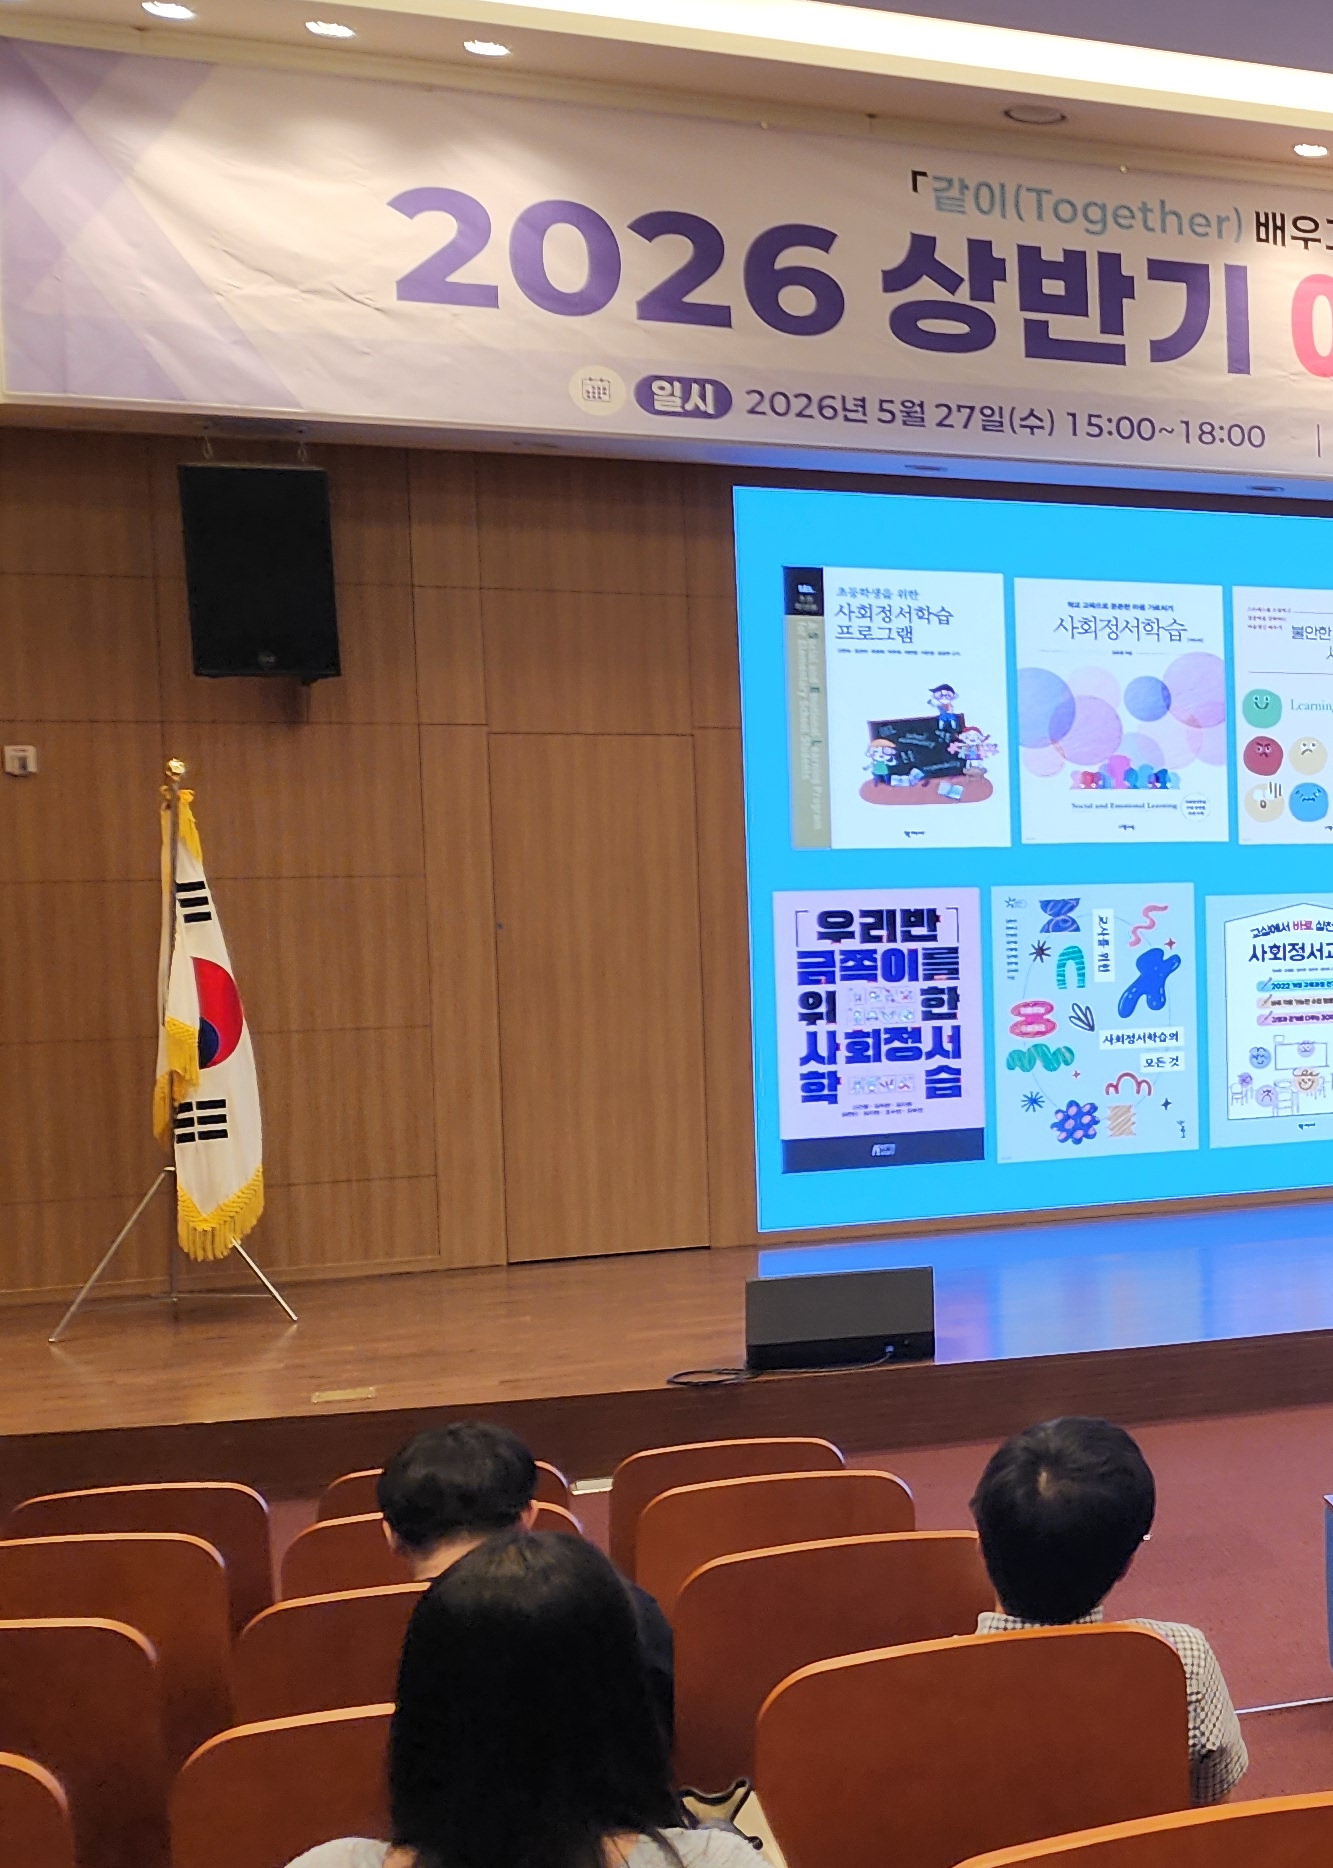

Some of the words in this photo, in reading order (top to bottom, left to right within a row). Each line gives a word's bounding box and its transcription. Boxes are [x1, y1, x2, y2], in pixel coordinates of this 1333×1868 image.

[385, 186, 847, 337] 2026
[881, 231, 1251, 376] 상반기
[651, 379, 716, 414] 일시
[746, 389, 868, 424] 2026년
[877, 399, 926, 428] 5월
[935, 403, 1055, 436] 27일(수)
[1067, 411, 1266, 448] 15:00~18:00
[898, 589, 920, 600] 위한
[834, 602, 954, 625] 사회정서학습
[835, 625, 914, 644] 프로그램
[1053, 614, 1188, 643] 사회정서학습
[1291, 625, 1331, 640] 불안한
[817, 907, 941, 944] 우리반
[797, 947, 960, 986] 금쪽이를
[1271, 982, 1290, 990] 2022
[799, 1025, 962, 1067] 사회정서
[1102, 1031, 1179, 1046] 사회정서학습의
[1143, 1056, 1167, 1068] 모든
[1168, 1056, 1180, 1068] 것
[799, 1070, 842, 1105] 학
[925, 1064, 962, 1100] 습
